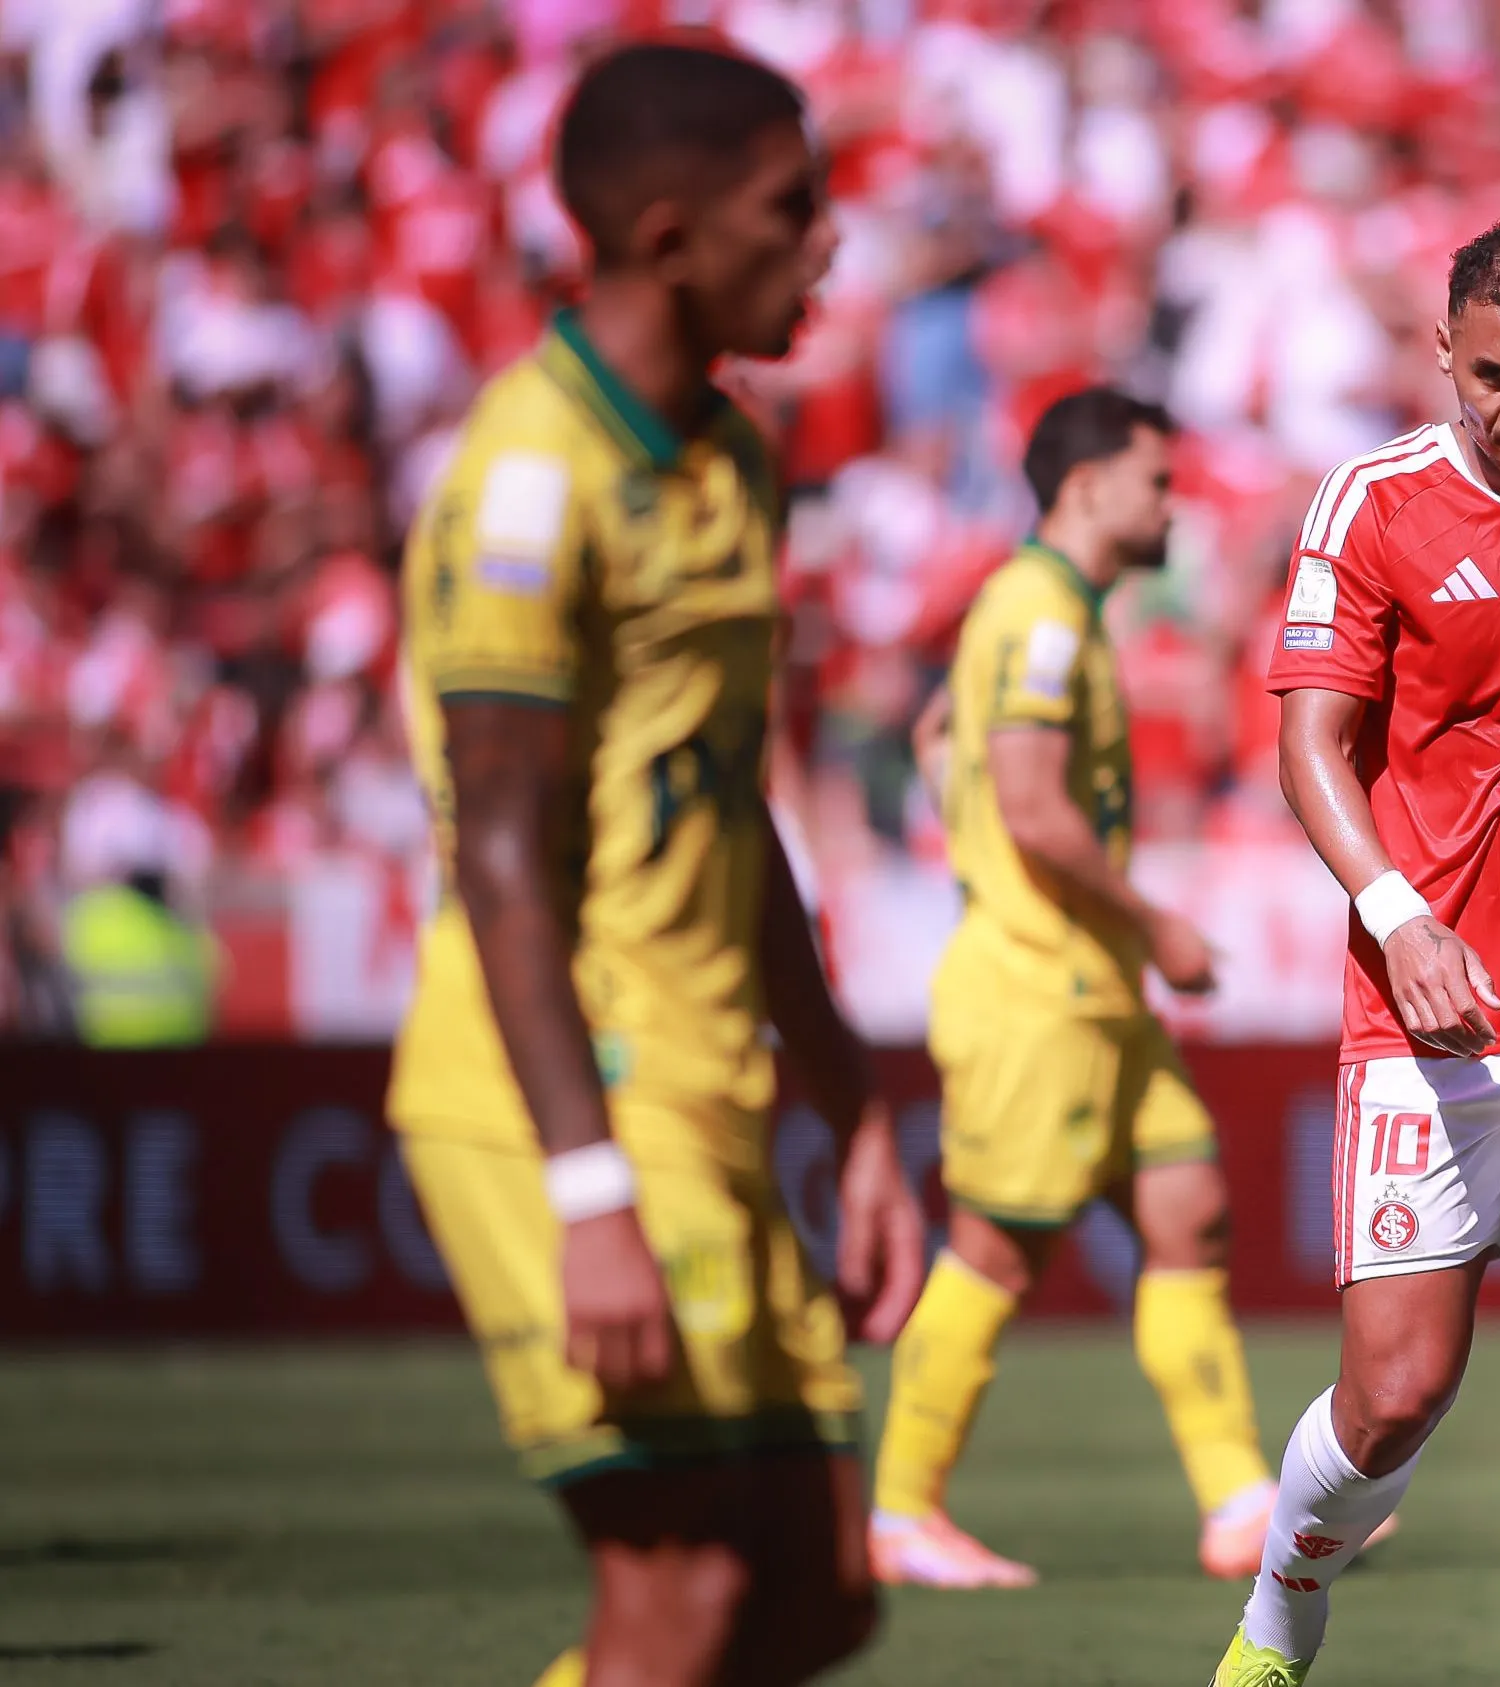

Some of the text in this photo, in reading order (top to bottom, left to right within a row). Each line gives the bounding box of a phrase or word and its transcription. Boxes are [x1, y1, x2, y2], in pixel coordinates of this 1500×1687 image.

[1286, 629, 1313, 638] NÃO AO
[1286, 638, 1328, 648] FEMINICÍDIO
[1370, 1112, 1432, 1176] 10
[0, 1106, 196, 1294] RE
